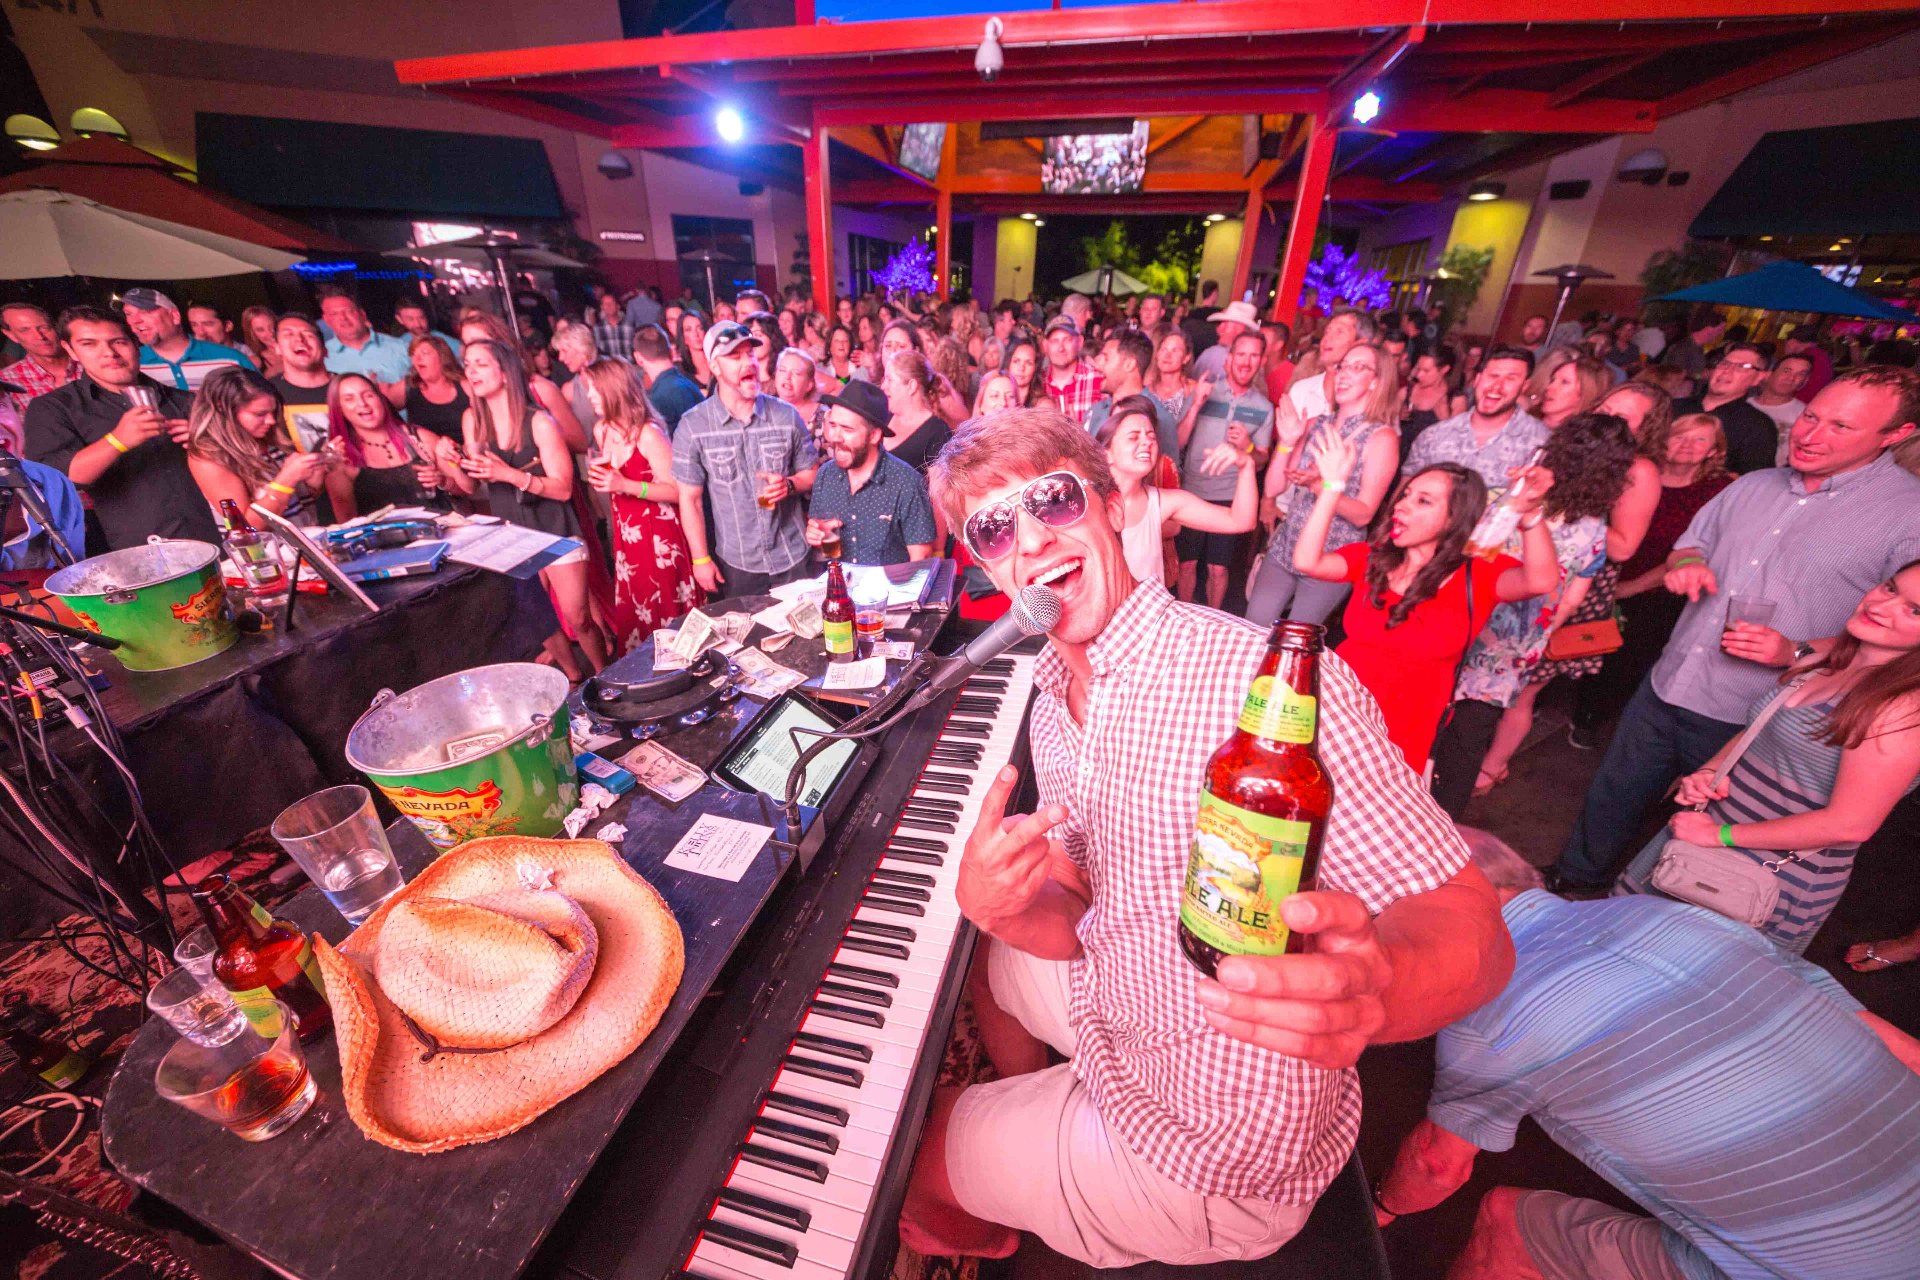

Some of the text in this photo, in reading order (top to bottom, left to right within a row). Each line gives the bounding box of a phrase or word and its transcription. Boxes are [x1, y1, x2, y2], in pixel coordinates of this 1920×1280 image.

[400, 800, 471, 811] NEVADA
[1219, 822, 1254, 849] NEVADA
[1185, 878, 1211, 908] ALE
[1216, 897, 1270, 930] ALE
